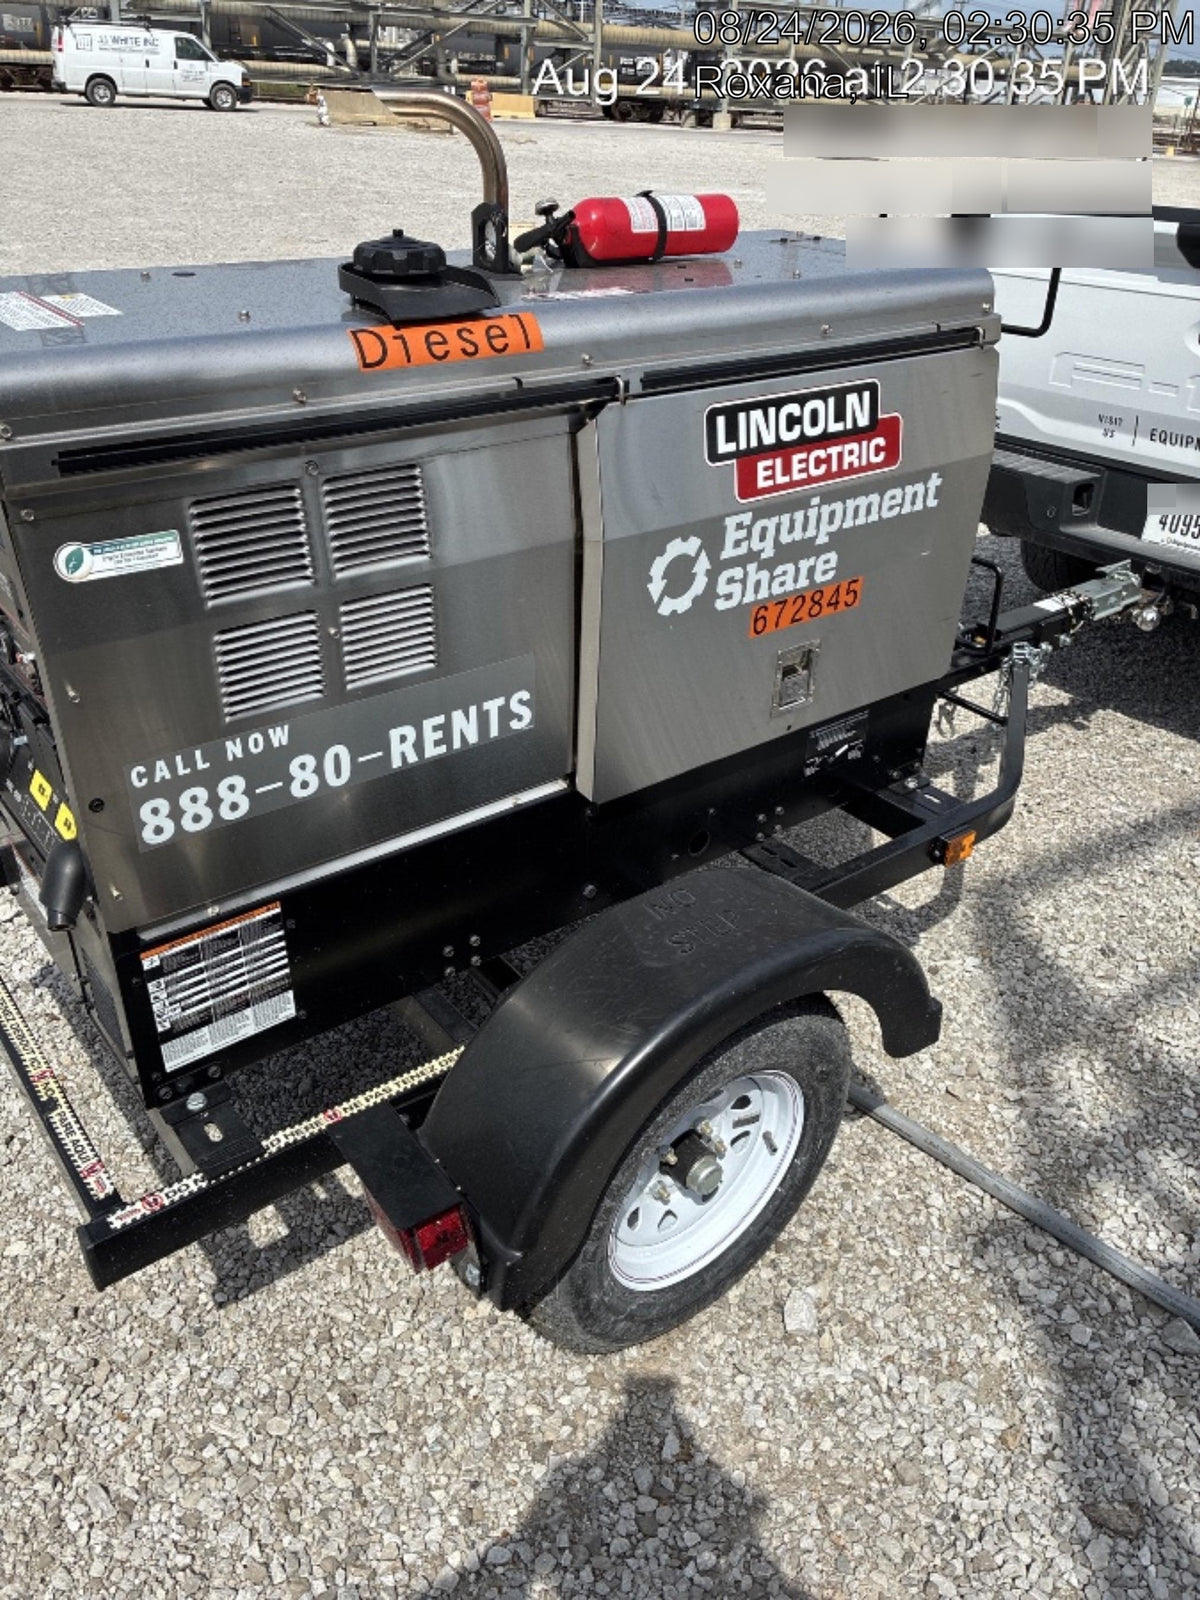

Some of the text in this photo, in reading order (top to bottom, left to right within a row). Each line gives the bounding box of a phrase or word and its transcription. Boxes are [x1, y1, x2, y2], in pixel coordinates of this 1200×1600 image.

[110, 35, 141, 46] WHITE
[350, 313, 531, 369] Diesel
[715, 390, 872, 455] LINCOLN
[756, 436, 887, 490] ELECTRIC
[719, 472, 943, 560] Equipment
[714, 550, 839, 612] Share
[752, 577, 859, 635] 672845
[129, 724, 290, 788] CALL NOW
